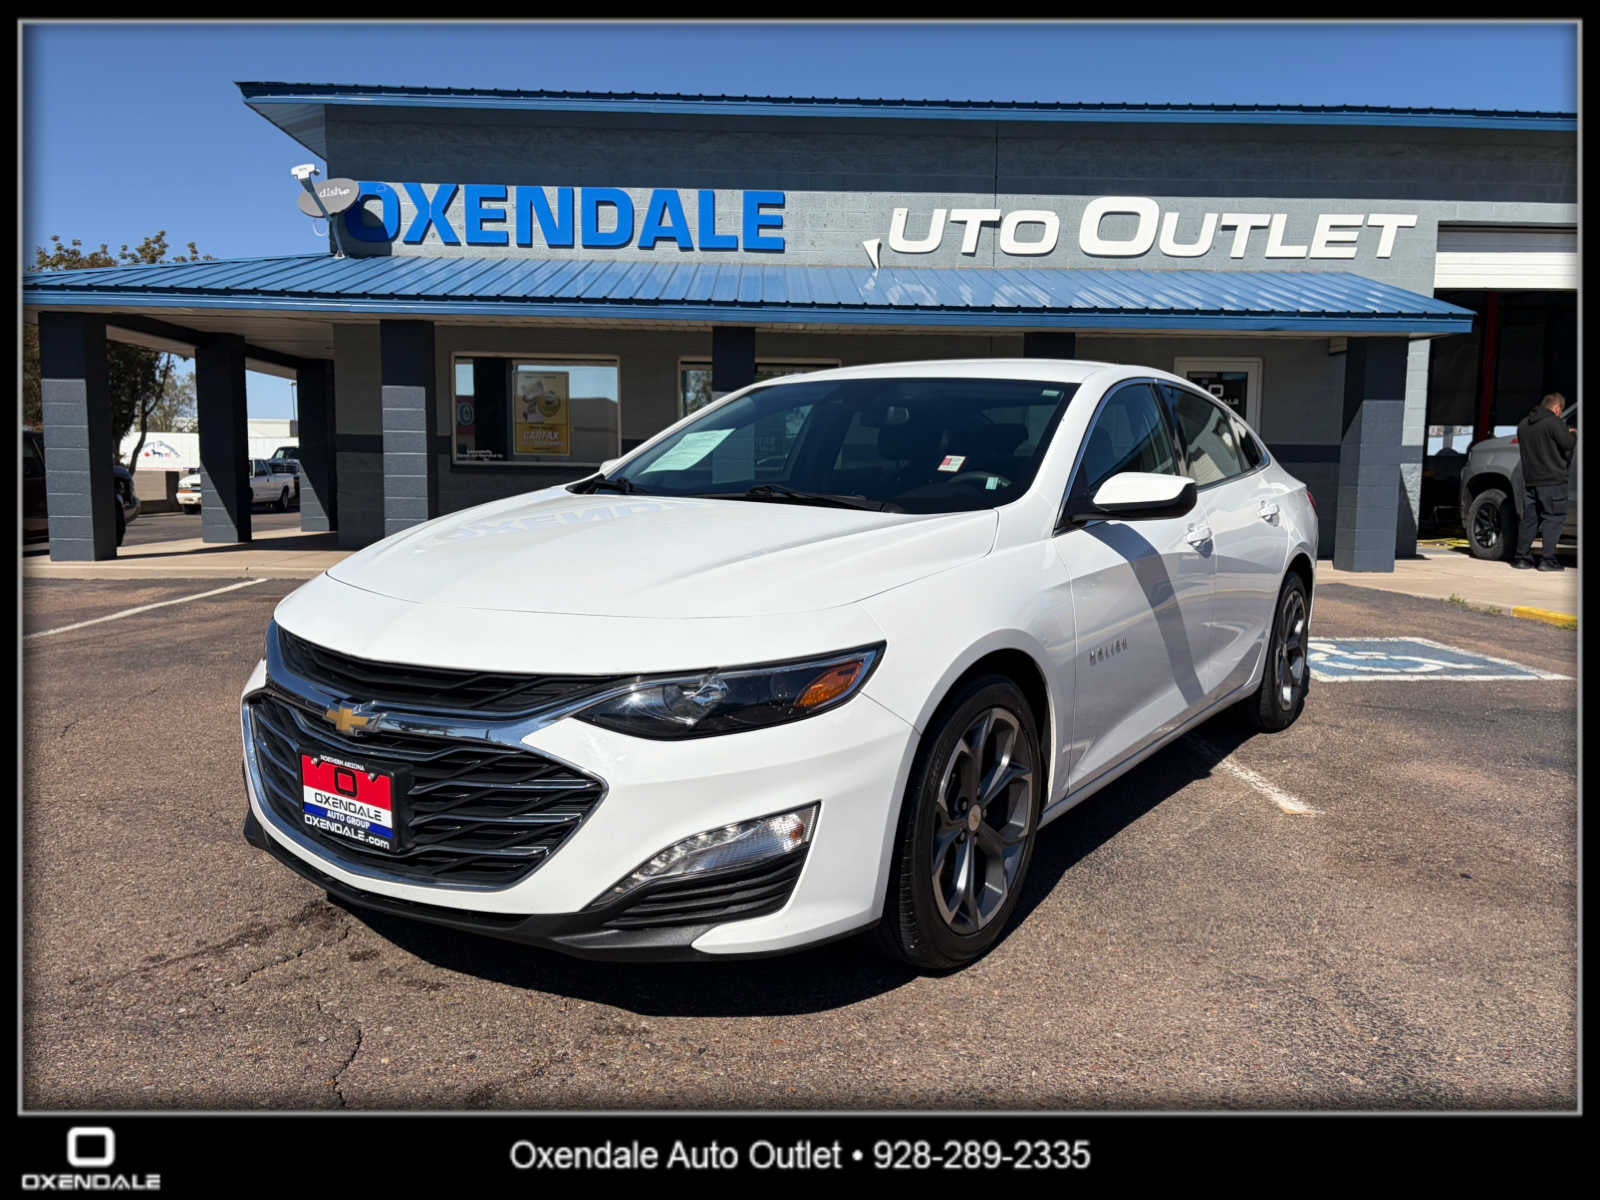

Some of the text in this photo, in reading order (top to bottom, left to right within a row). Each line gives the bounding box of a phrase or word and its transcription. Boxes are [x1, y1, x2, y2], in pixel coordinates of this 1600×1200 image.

[345, 181, 786, 252] OXENDALE
[1078, 196, 1418, 259] OUTLET
[314, 792, 383, 822] OXENDALE
[326, 810, 371, 829] AUTO GROUP
[304, 813, 390, 850] OXENDALE.com
